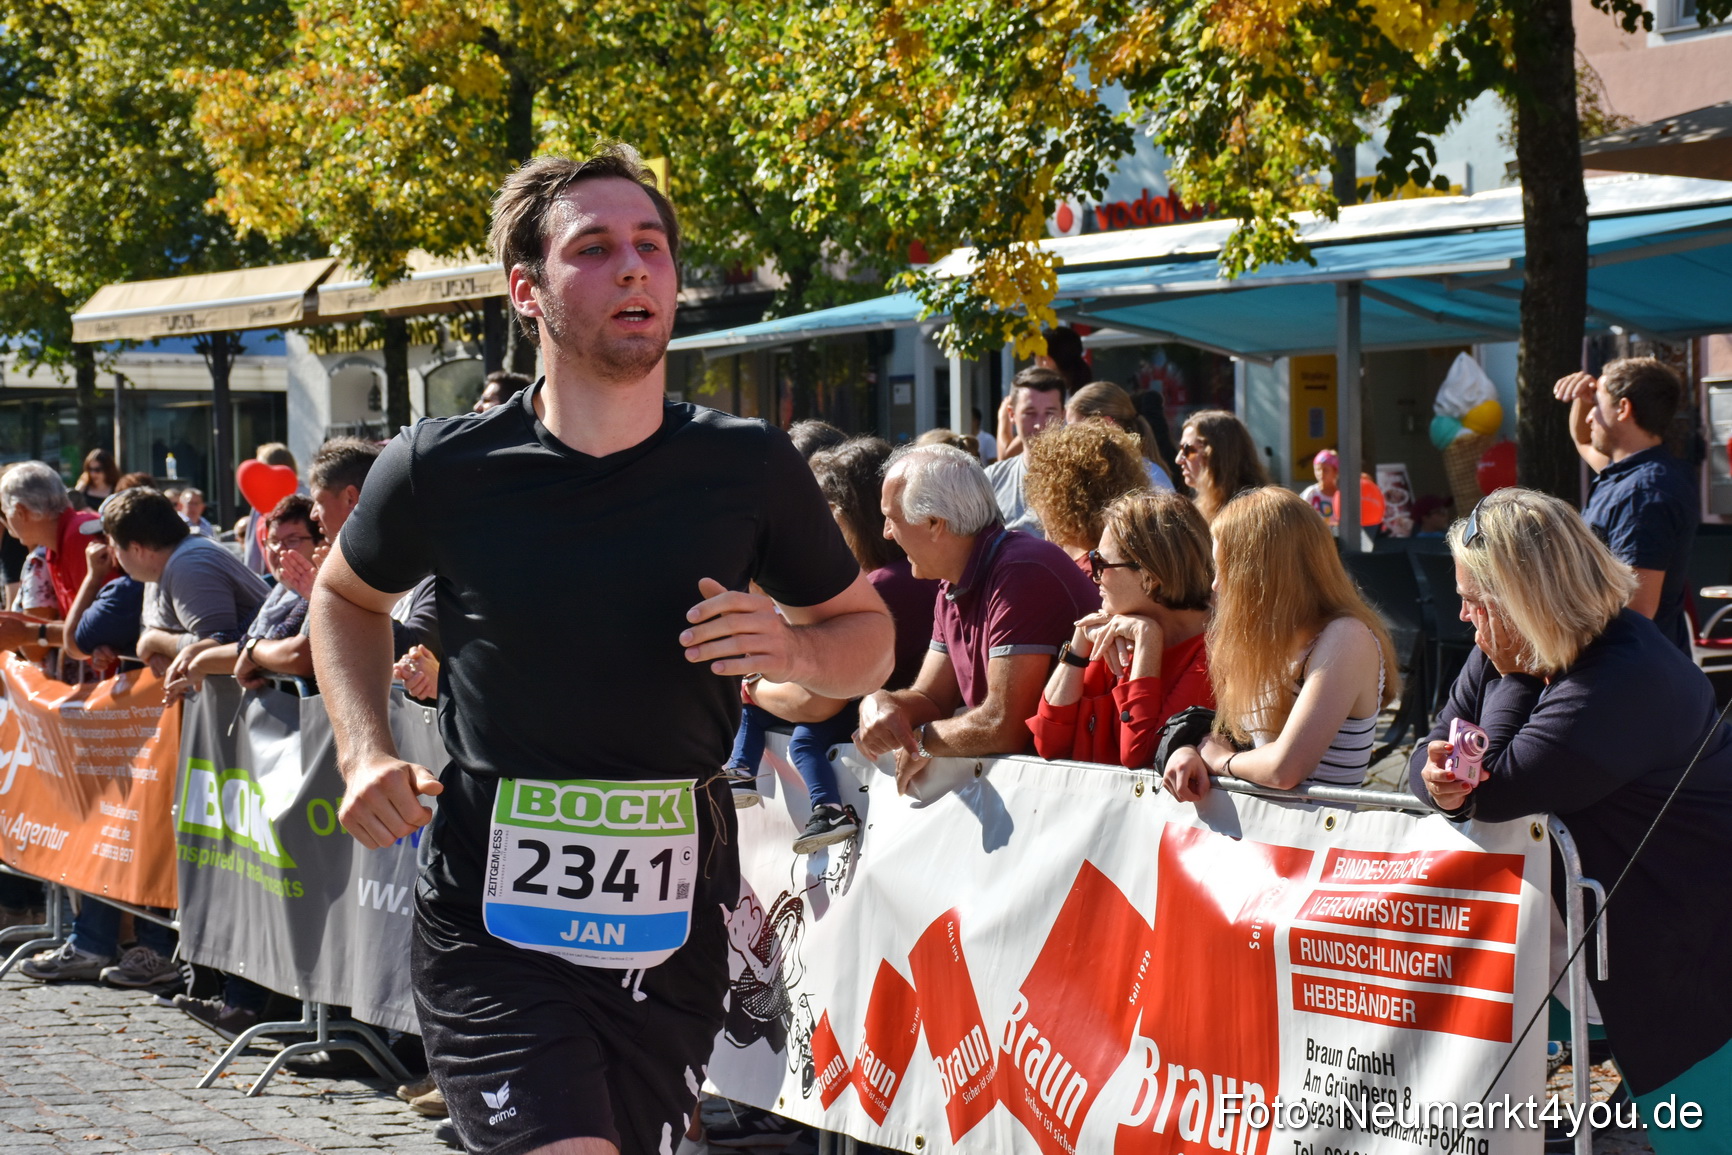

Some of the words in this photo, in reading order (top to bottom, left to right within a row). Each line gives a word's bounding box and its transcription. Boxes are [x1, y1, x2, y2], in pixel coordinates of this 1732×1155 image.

[1095, 185, 1212, 231] vodafo
[512, 780, 686, 829] BOCK
[9, 812, 69, 852] Agentur
[512, 839, 673, 903] 2341
[683, 850, 691, 861] C
[1332, 856, 1434, 880] BINDESTRICKE
[560, 919, 626, 945] JAN
[1309, 895, 1471, 932] VERZURRSYSTEME
[1128, 982, 1141, 1006] Seit
[1137, 950, 1151, 980] 1929
[1300, 937, 1453, 979] RUNDSCHLINGEN
[1303, 982, 1417, 1023] HEBEBÄNDER
[813, 1054, 845, 1098] Braun
[857, 1028, 897, 1098] Braun
[934, 1024, 990, 1105] Braun
[1000, 991, 1088, 1129] Braun
[1306, 1037, 1343, 1068] Braun
[1347, 1046, 1396, 1077] GmbH
[962, 1086, 980, 1105] Sicher
[1025, 1087, 1043, 1121] Sicher
[1043, 1113, 1053, 1133] ist
[1119, 1035, 1265, 1155] Braun
[1303, 1068, 1322, 1094] Am
[1324, 1072, 1397, 1113] Grünberg
[1404, 1086, 1412, 1110] 8
[489, 1106, 517, 1126] erima
